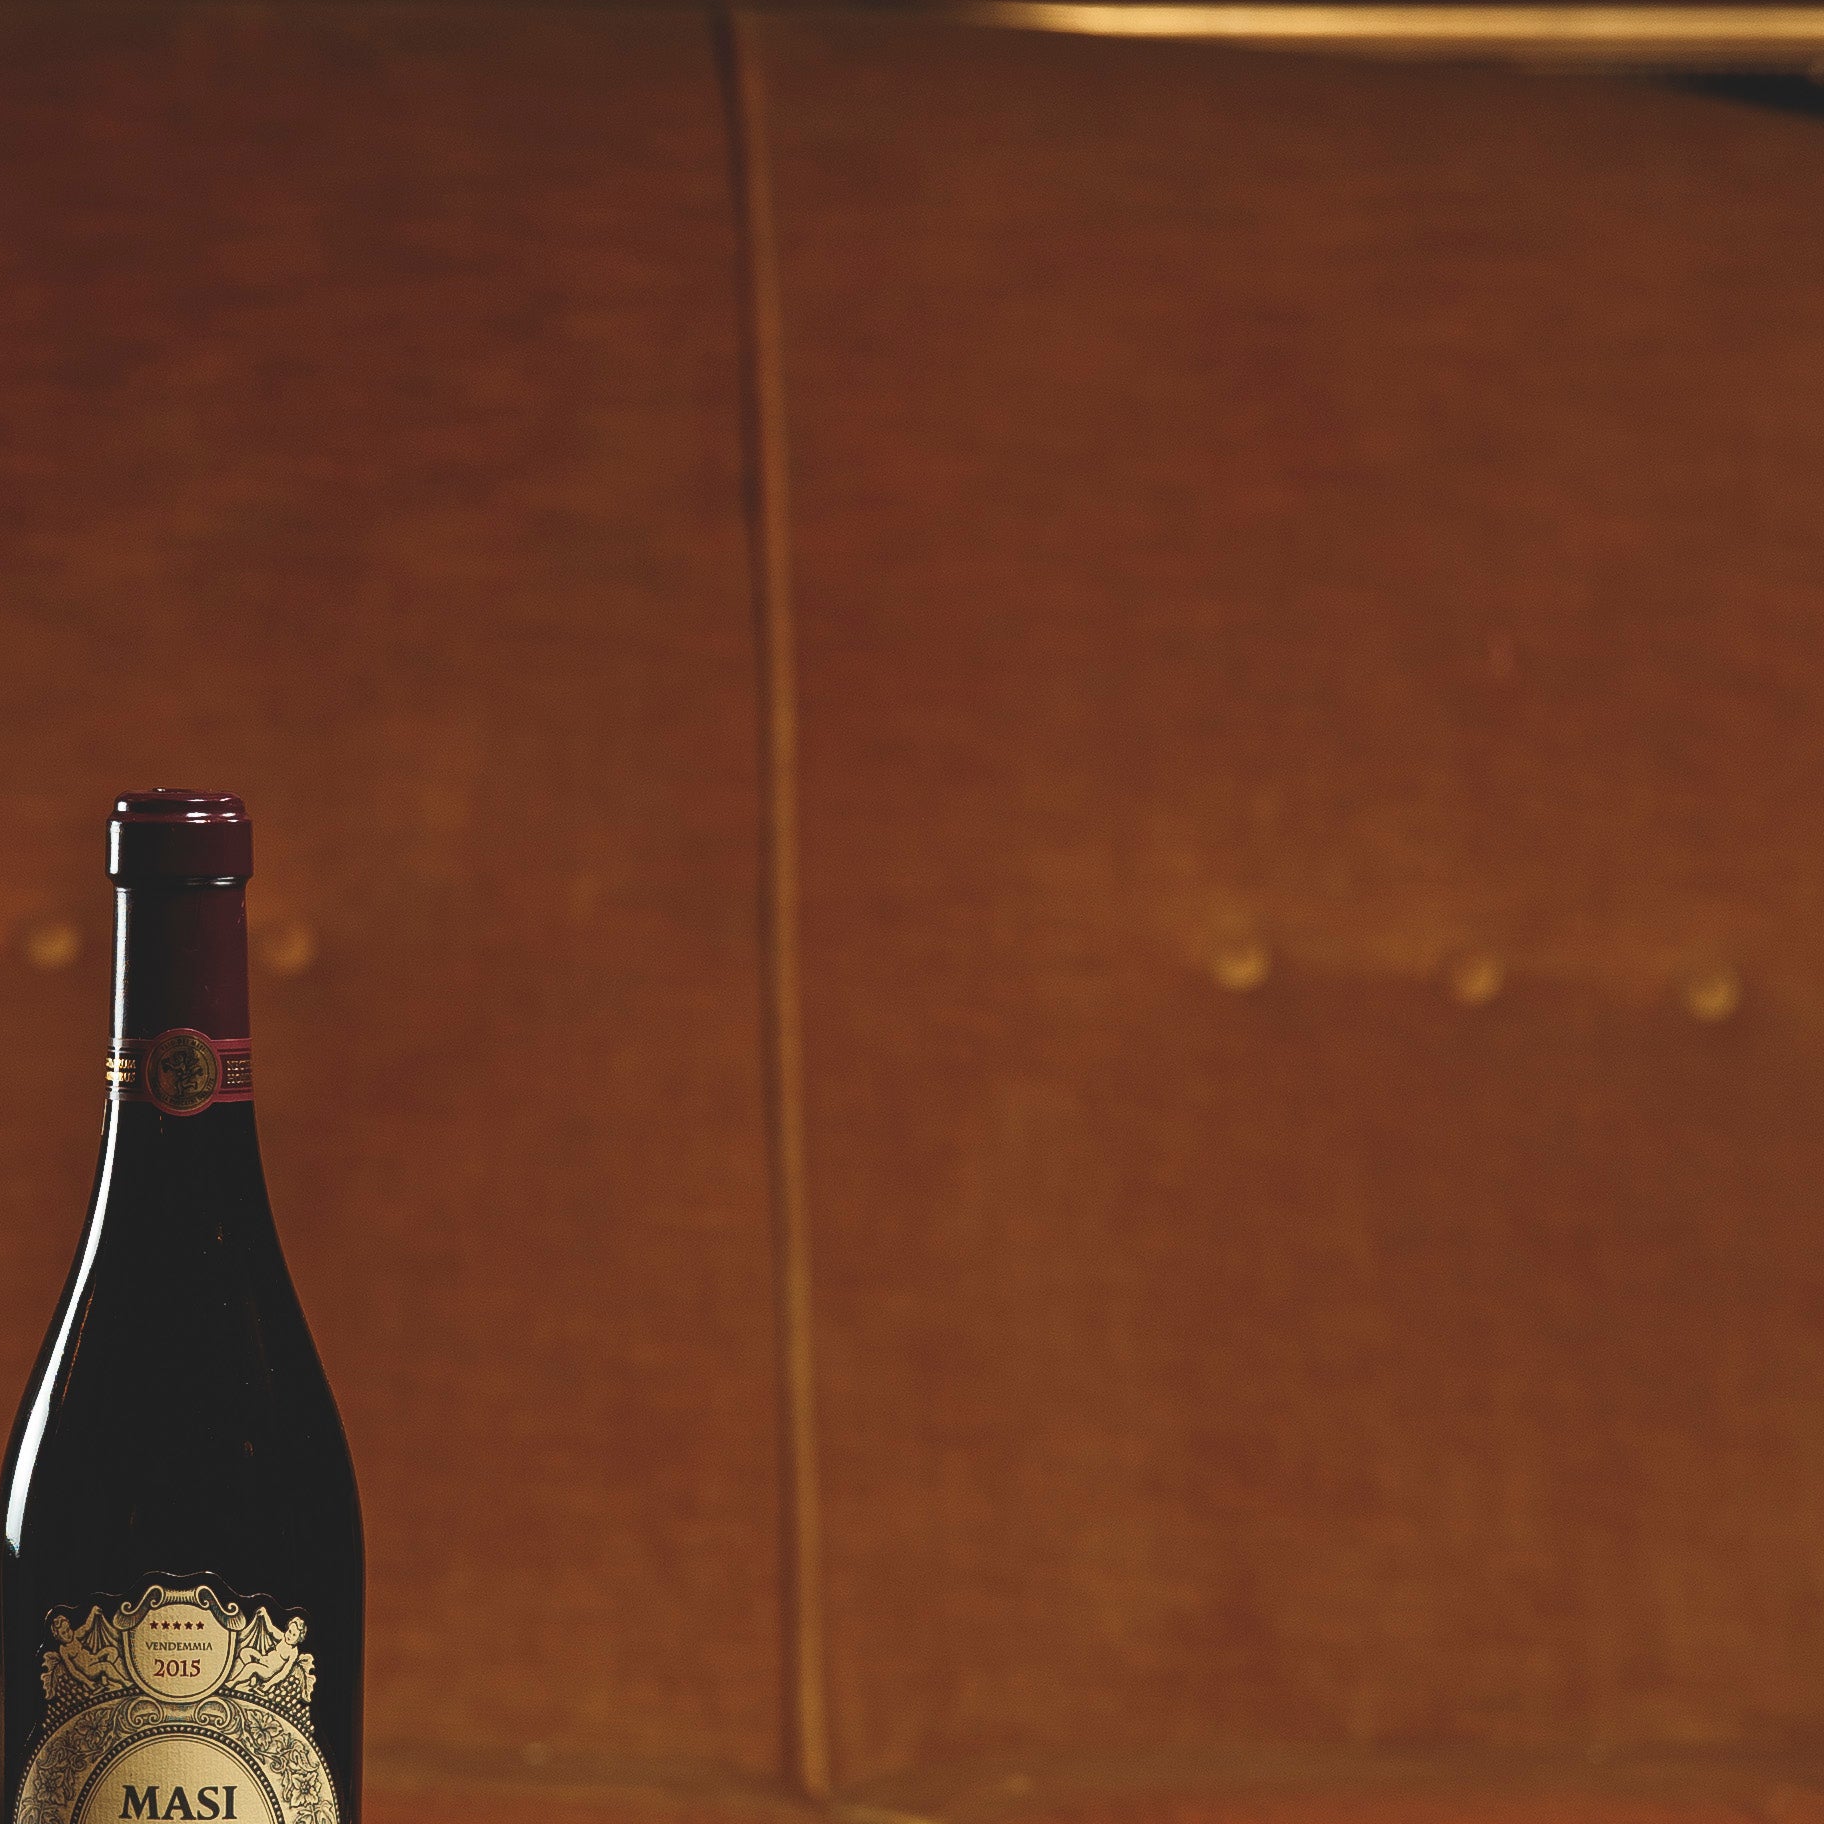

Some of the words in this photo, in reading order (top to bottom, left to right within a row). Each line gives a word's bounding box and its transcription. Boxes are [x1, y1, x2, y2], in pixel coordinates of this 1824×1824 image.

[145, 1640, 213, 1652] VENDEMMIA
[154, 1658, 201, 1679] 2015
[120, 1785, 237, 1820] MASI
